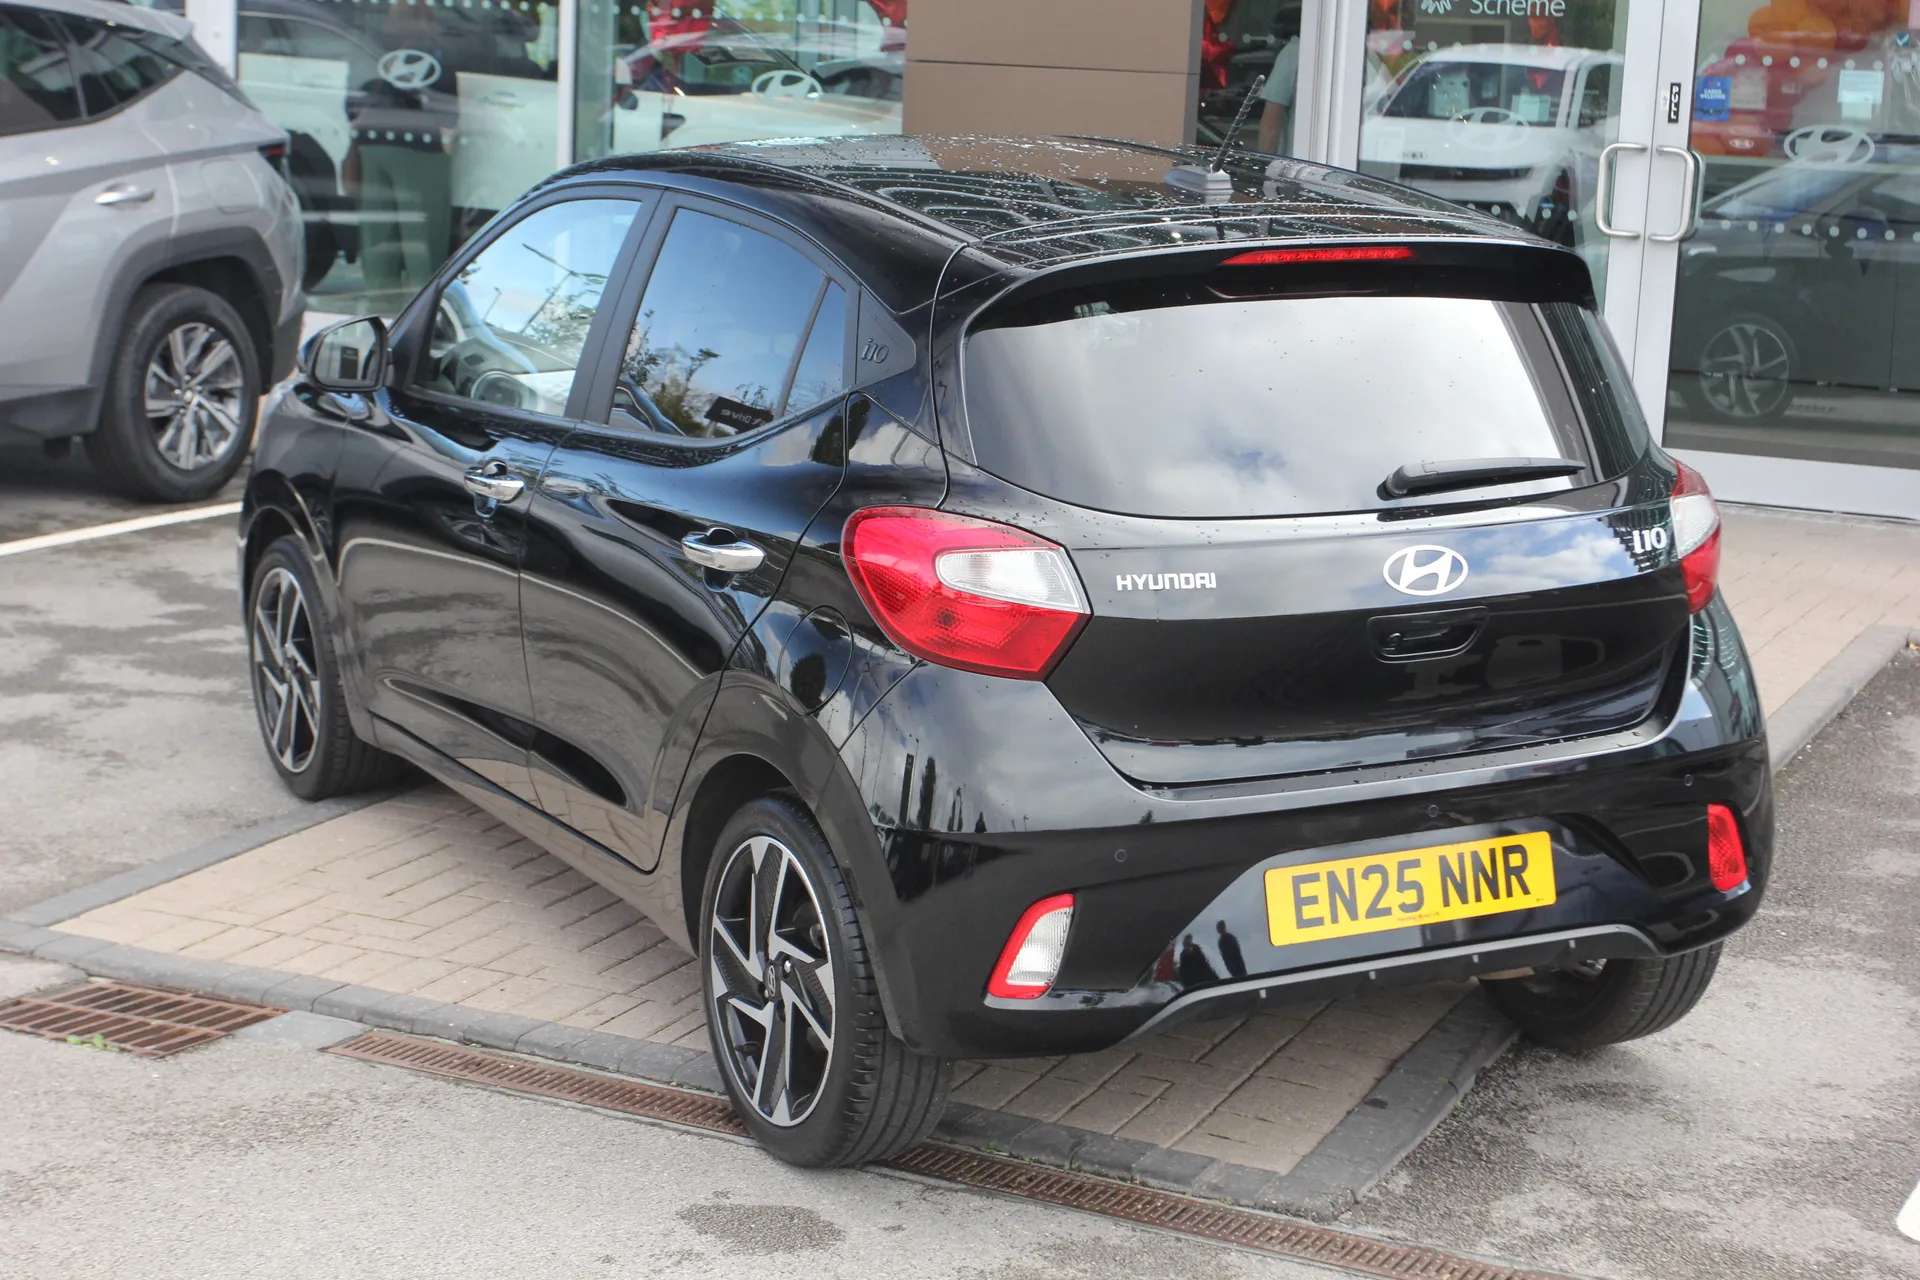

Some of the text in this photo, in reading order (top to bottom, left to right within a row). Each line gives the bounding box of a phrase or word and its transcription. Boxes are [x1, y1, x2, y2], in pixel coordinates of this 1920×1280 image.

[1469, 0, 1566, 17] Scheme
[1670, 85, 1680, 120] PULL
[1116, 572, 1217, 591] HYUNDAI
[1291, 844, 1532, 930] EN25 NNR
